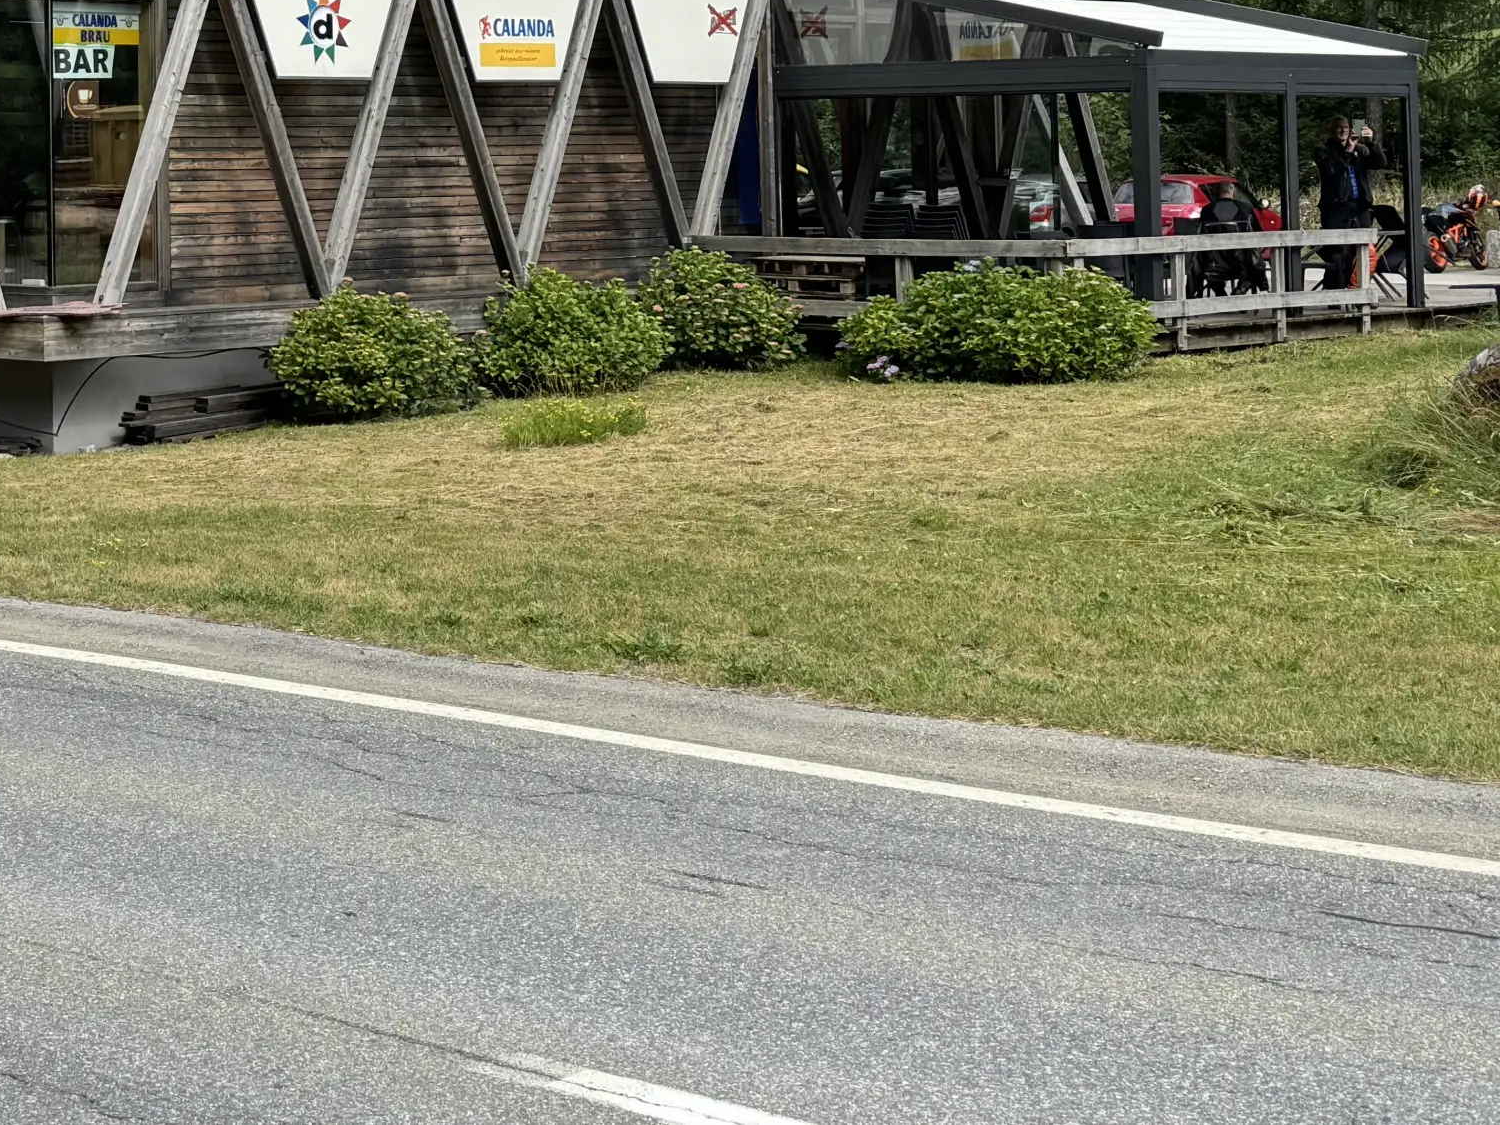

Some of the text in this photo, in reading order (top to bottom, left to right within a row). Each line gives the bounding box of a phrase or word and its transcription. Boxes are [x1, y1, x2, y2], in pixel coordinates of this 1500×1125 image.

[72, 14, 118, 28] CALANDA
[313, 13, 334, 41] d
[493, 17, 555, 38] CALANDA
[54, 48, 109, 74] BAR
